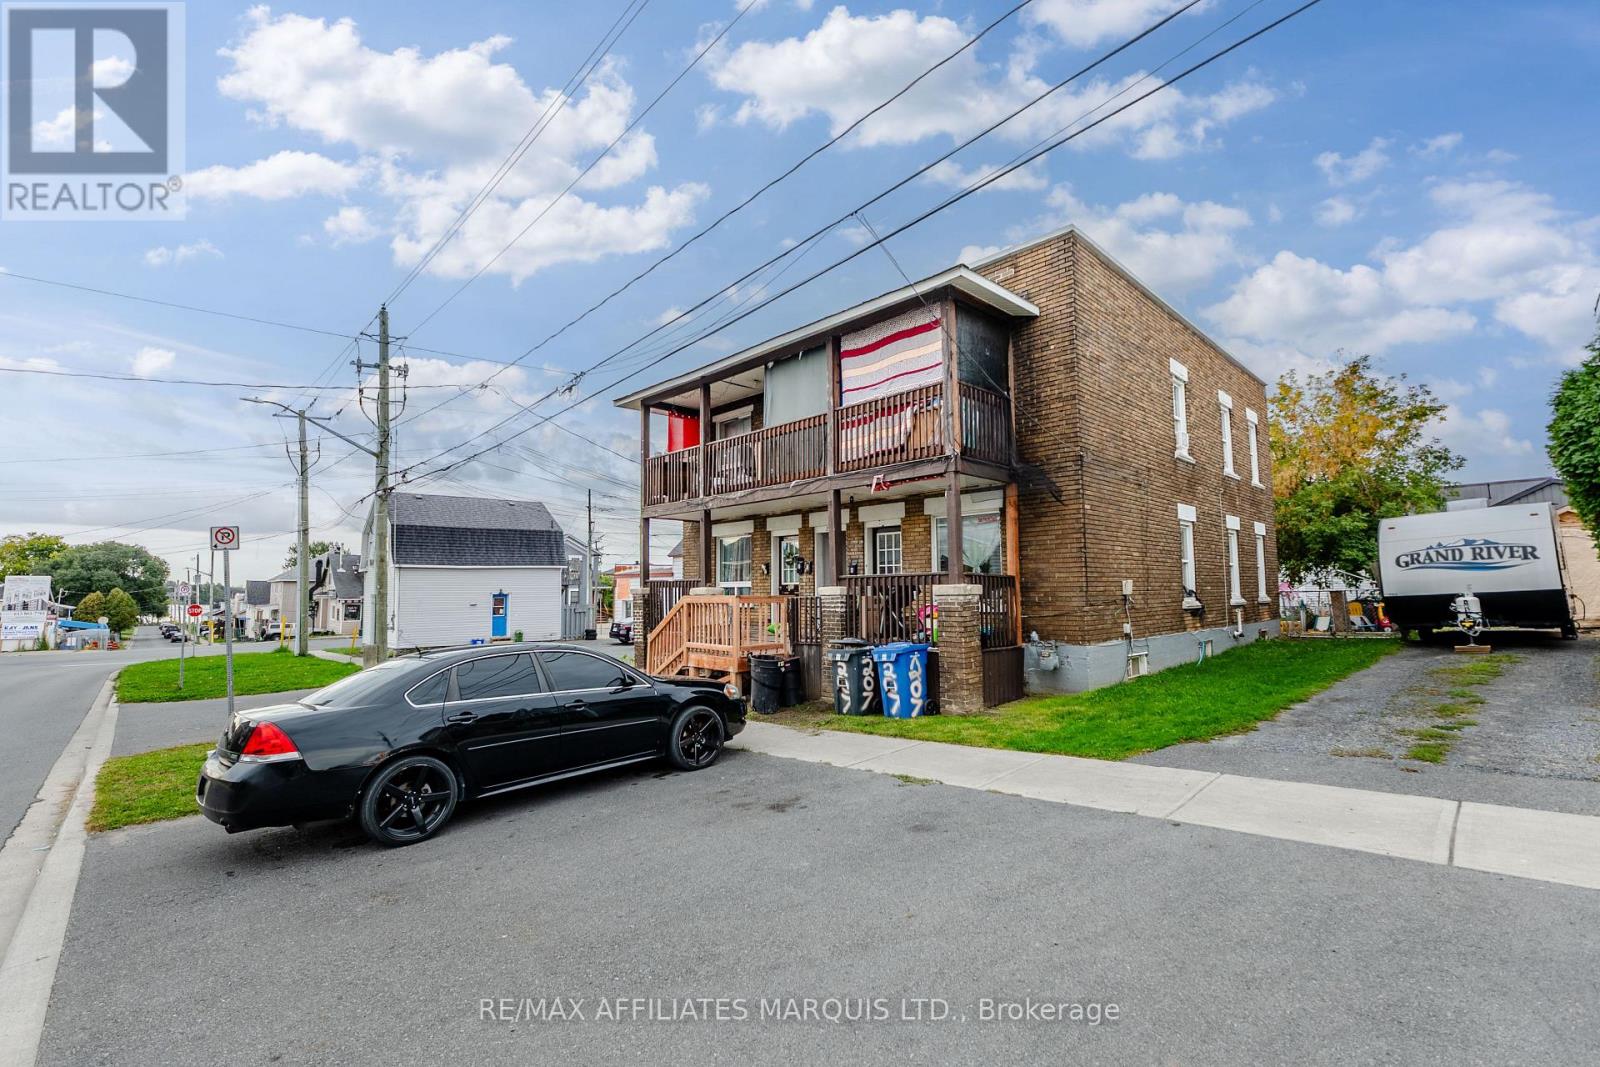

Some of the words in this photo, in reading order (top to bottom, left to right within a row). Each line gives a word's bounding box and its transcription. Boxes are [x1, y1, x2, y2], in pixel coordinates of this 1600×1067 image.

[1395, 548, 1464, 569] GRAND
[1471, 545, 1541, 561] RIVER
[860, 658, 875, 712] 207
